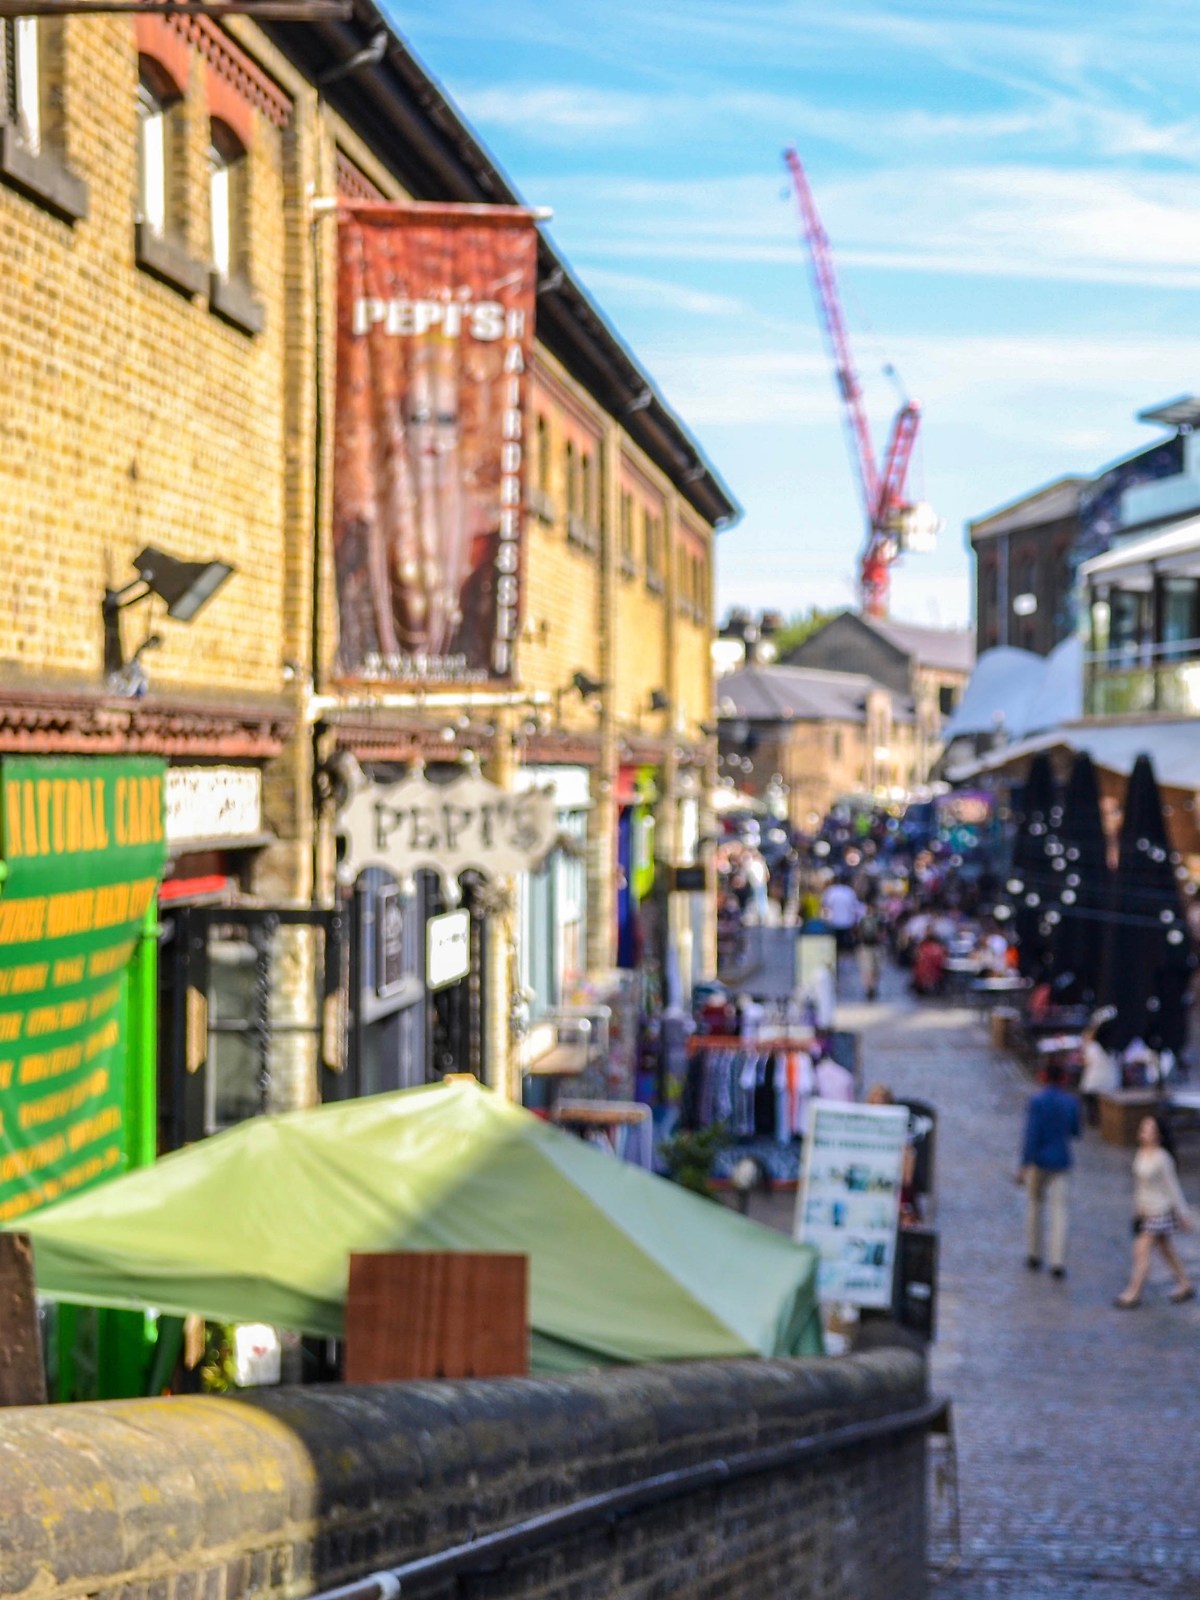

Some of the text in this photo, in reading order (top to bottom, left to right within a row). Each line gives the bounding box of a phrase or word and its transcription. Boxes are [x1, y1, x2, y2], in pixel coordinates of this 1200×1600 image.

[352, 296, 505, 341] PEPI'S
[7, 774, 163, 857] NATURAL CARE
[373, 800, 540, 851] PEPI'S
